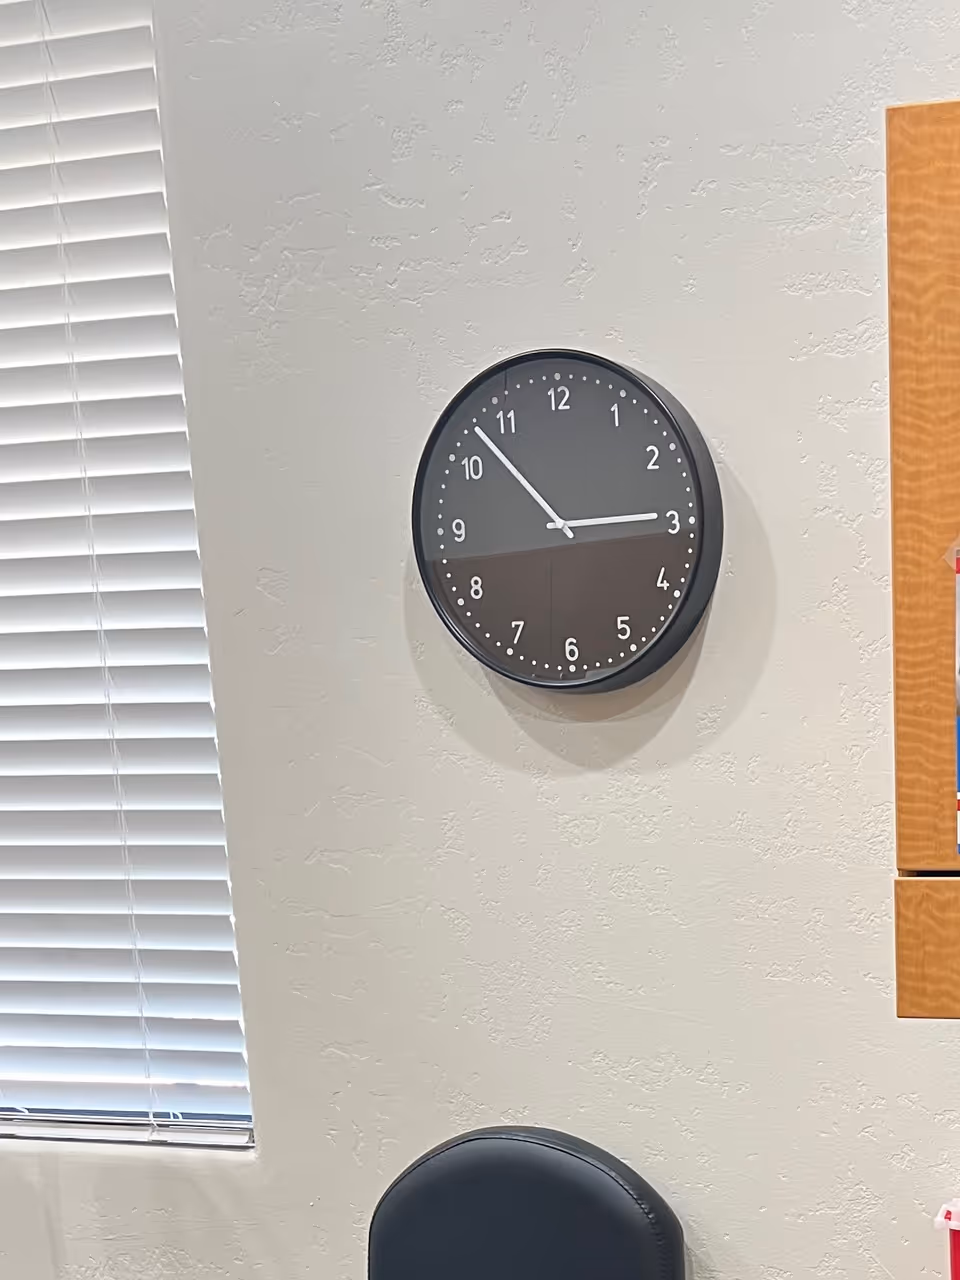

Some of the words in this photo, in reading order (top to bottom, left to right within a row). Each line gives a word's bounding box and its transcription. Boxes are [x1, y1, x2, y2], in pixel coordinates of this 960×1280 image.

[548, 386, 570, 411] 12
[496, 410, 516, 434] 11
[611, 403, 620, 427] 1
[461, 456, 483, 480] 10
[646, 445, 660, 470] 2
[452, 519, 466, 543] 9
[666, 510, 680, 535] 3
[470, 576, 483, 600] 8
[656, 567, 670, 590] 4
[511, 620, 525, 644] 7
[617, 616, 631, 640] 5
[565, 638, 579, 661] 6
